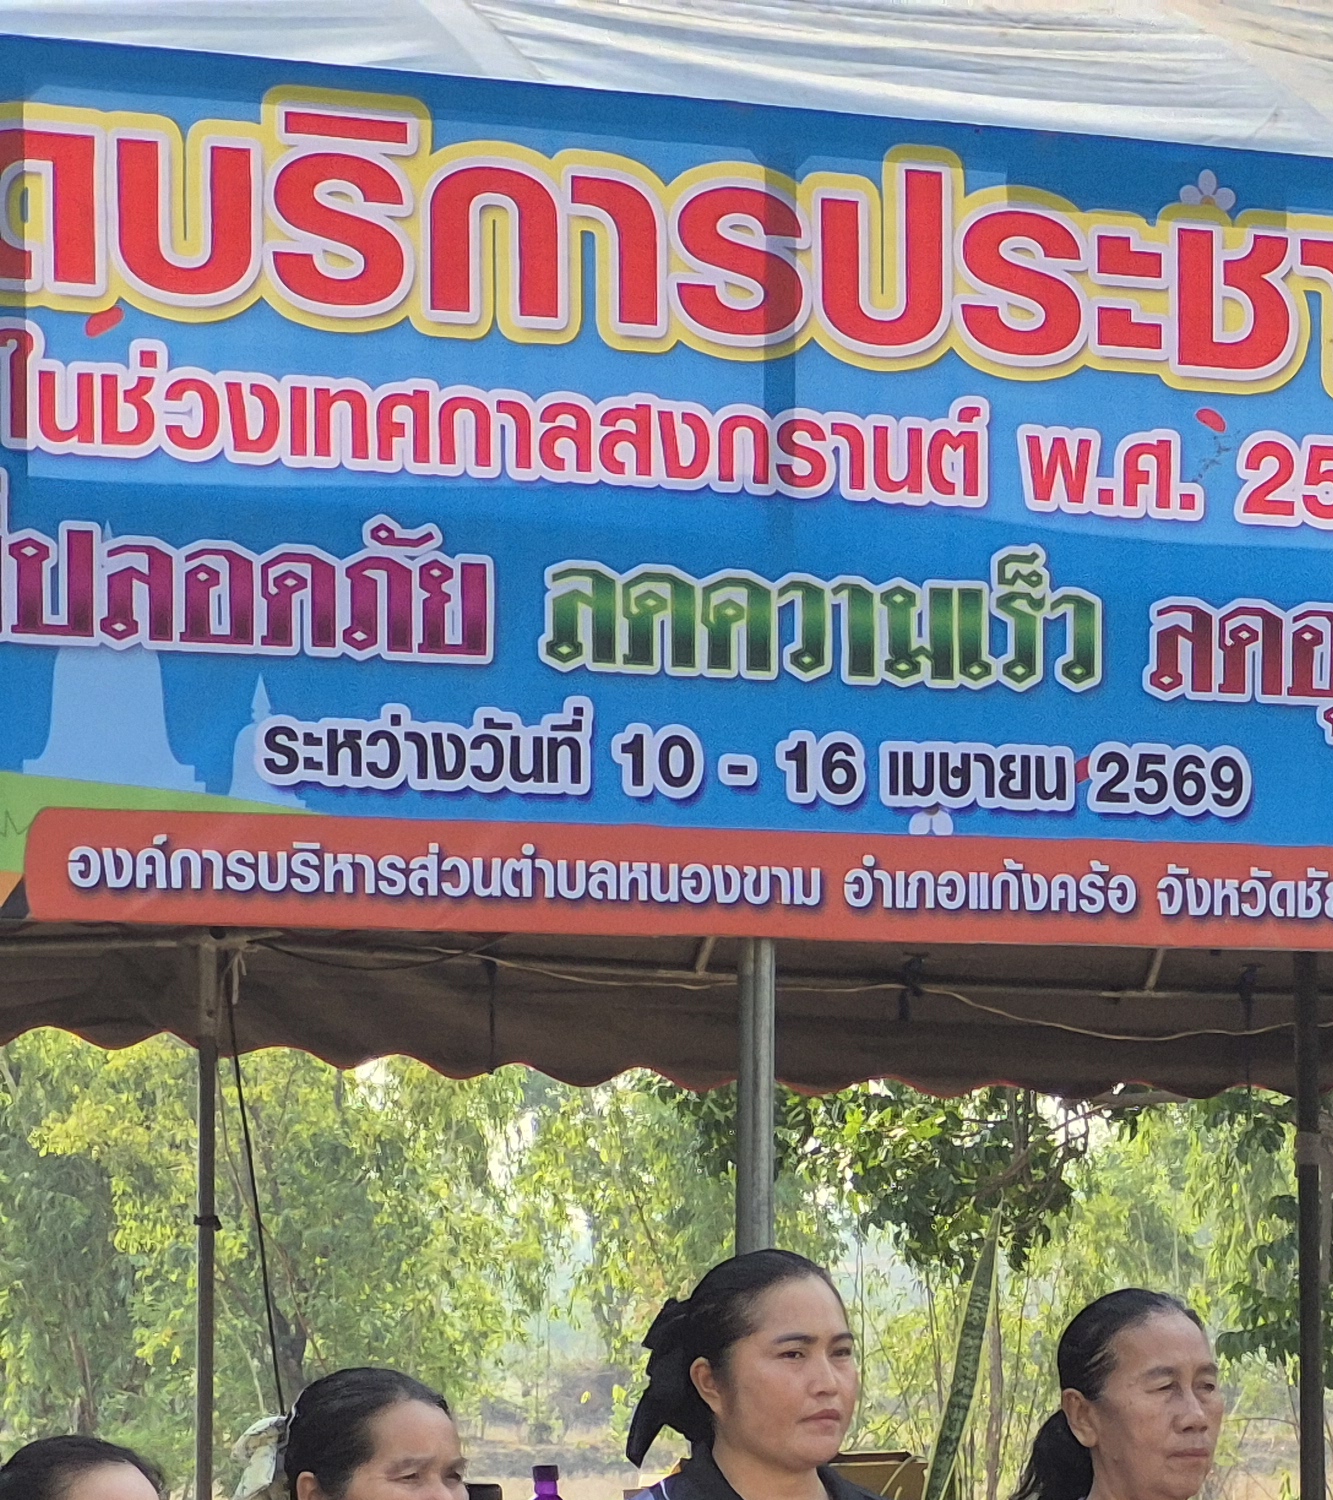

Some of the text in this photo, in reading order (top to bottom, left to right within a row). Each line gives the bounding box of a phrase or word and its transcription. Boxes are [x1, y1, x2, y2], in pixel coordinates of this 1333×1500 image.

[0, 327, 987, 499] ในช่วงเทศกาลสงกรานต์
[1024, 432, 1197, 513] พ.ศ.
[0, 522, 493, 656] ปลอดภัย
[546, 550, 1099, 684] ลดความเร็ว
[263, 708, 1245, 806] ระหว่างวันที่ 10 - 16 เมษายน 2569
[67, 834, 822, 906] องค์การบริหารส่วนตำบลหนองขาม
[844, 859, 1138, 916] อำเภอแก้งคร้อ
